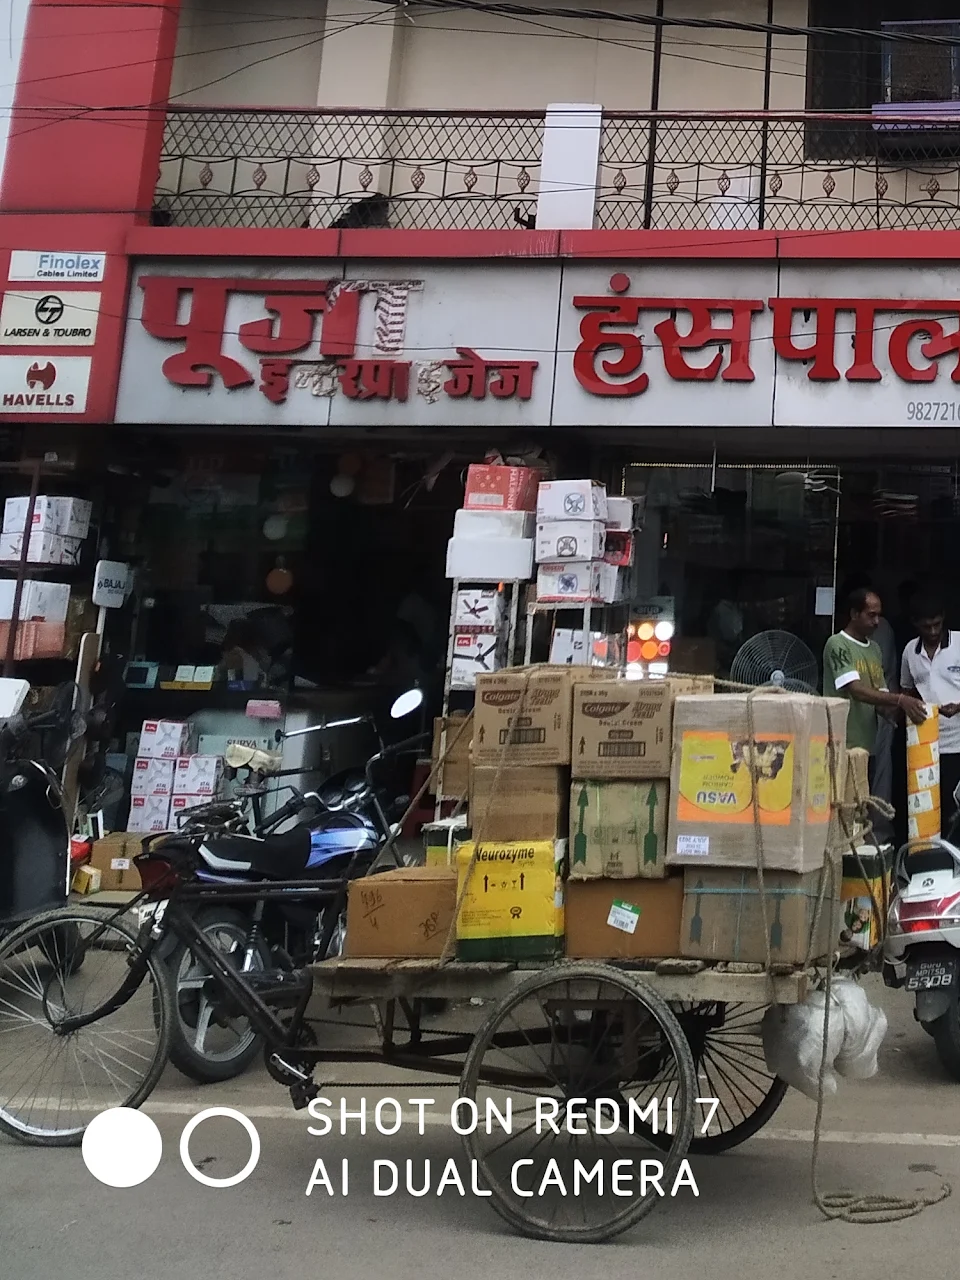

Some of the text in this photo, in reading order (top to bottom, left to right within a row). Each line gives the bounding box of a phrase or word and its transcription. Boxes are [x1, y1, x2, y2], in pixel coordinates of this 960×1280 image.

[38, 254, 101, 270] Finolex
[36, 270, 98, 279] Cables Limited
[3, 327, 92, 338] LARSEN & TOUBRO
[2, 393, 75, 407] HAVELLS
[584, 703, 621, 714] Colgate
[696, 790, 737, 805] VASU
[475, 846, 535, 866] Neurozyme
